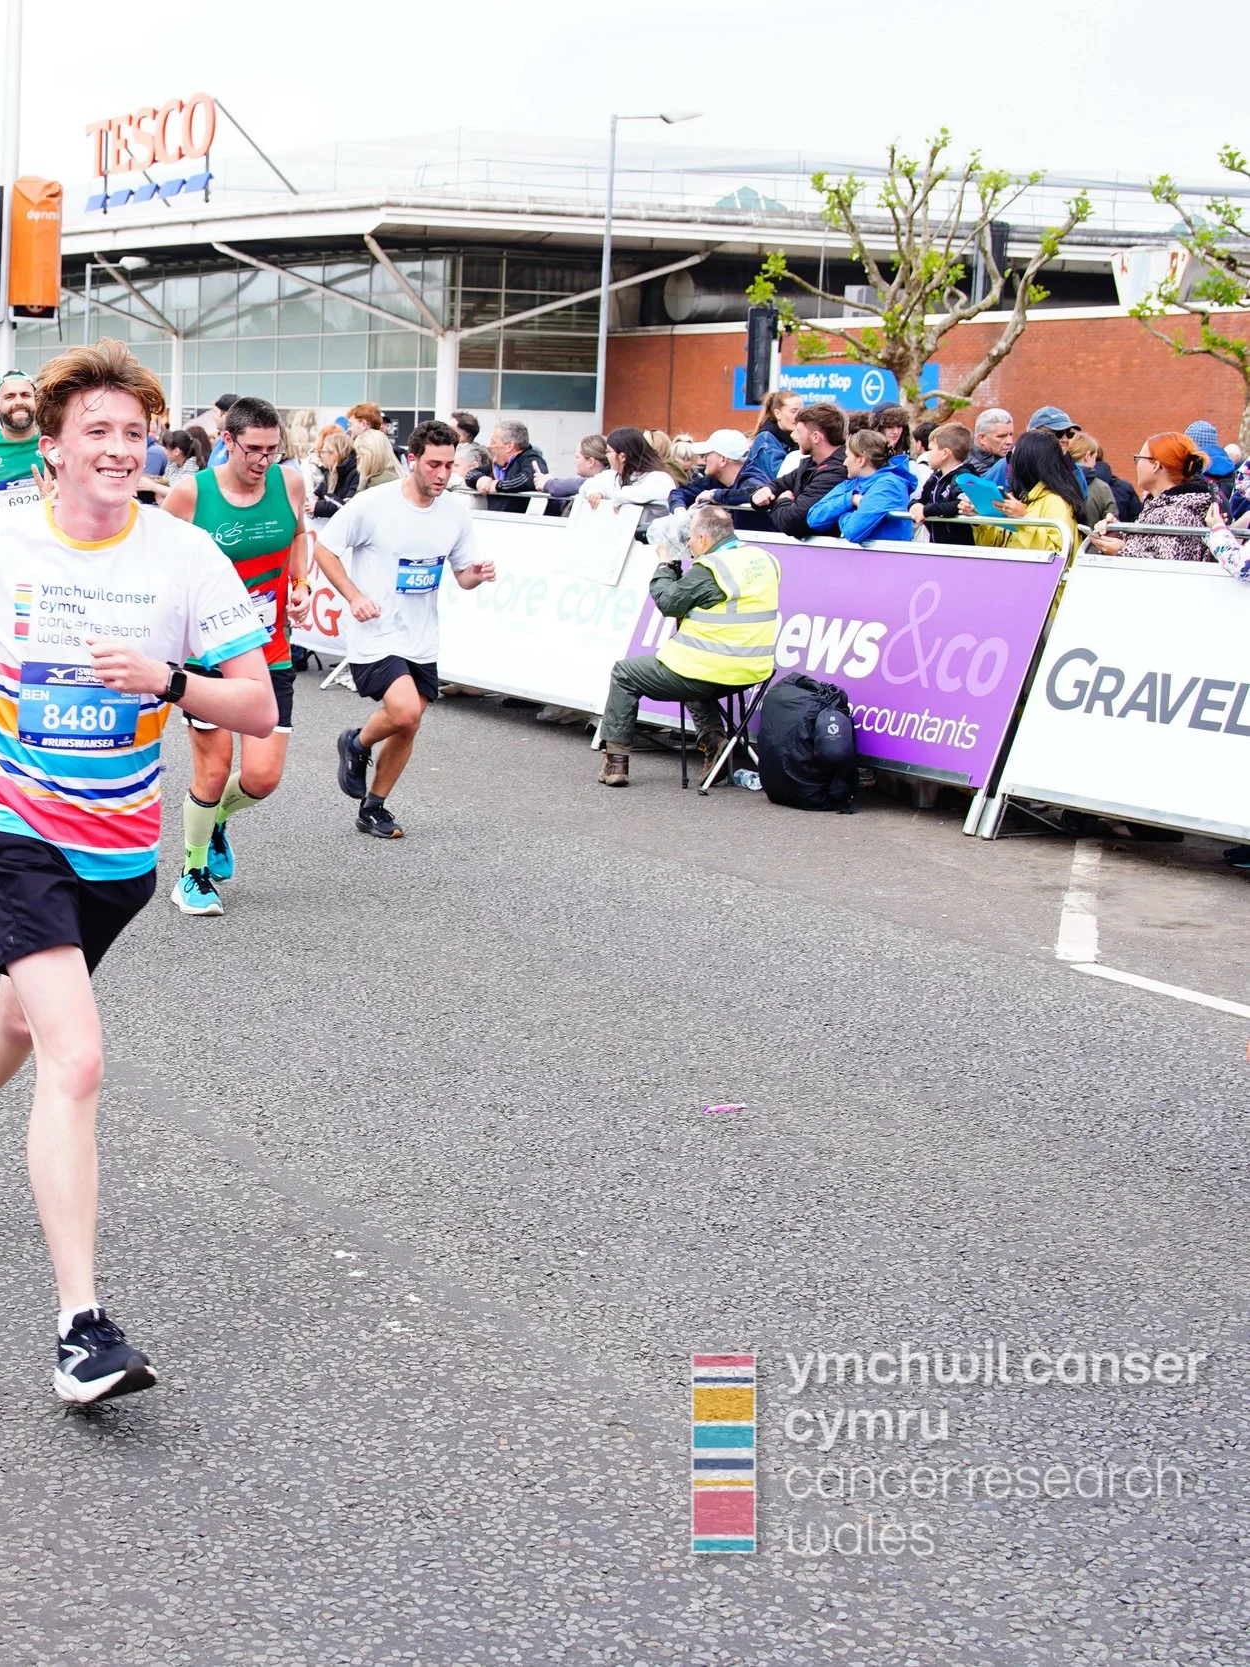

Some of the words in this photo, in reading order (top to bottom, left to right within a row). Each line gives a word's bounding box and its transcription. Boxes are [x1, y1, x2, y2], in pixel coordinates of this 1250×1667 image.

[86, 92, 216, 178] TESCO
[405, 573, 436, 587] 4508
[41, 584, 104, 600] ymchwil
[106, 591, 157, 604] canser
[39, 600, 86, 615] cymru
[38, 616, 88, 631] cancer
[89, 622, 151, 638] research
[37, 632, 81, 647] wales
[21, 688, 50, 701] BEN
[42, 703, 116, 731] 8480
[41, 737, 115, 748] #RUNSWANSEA
